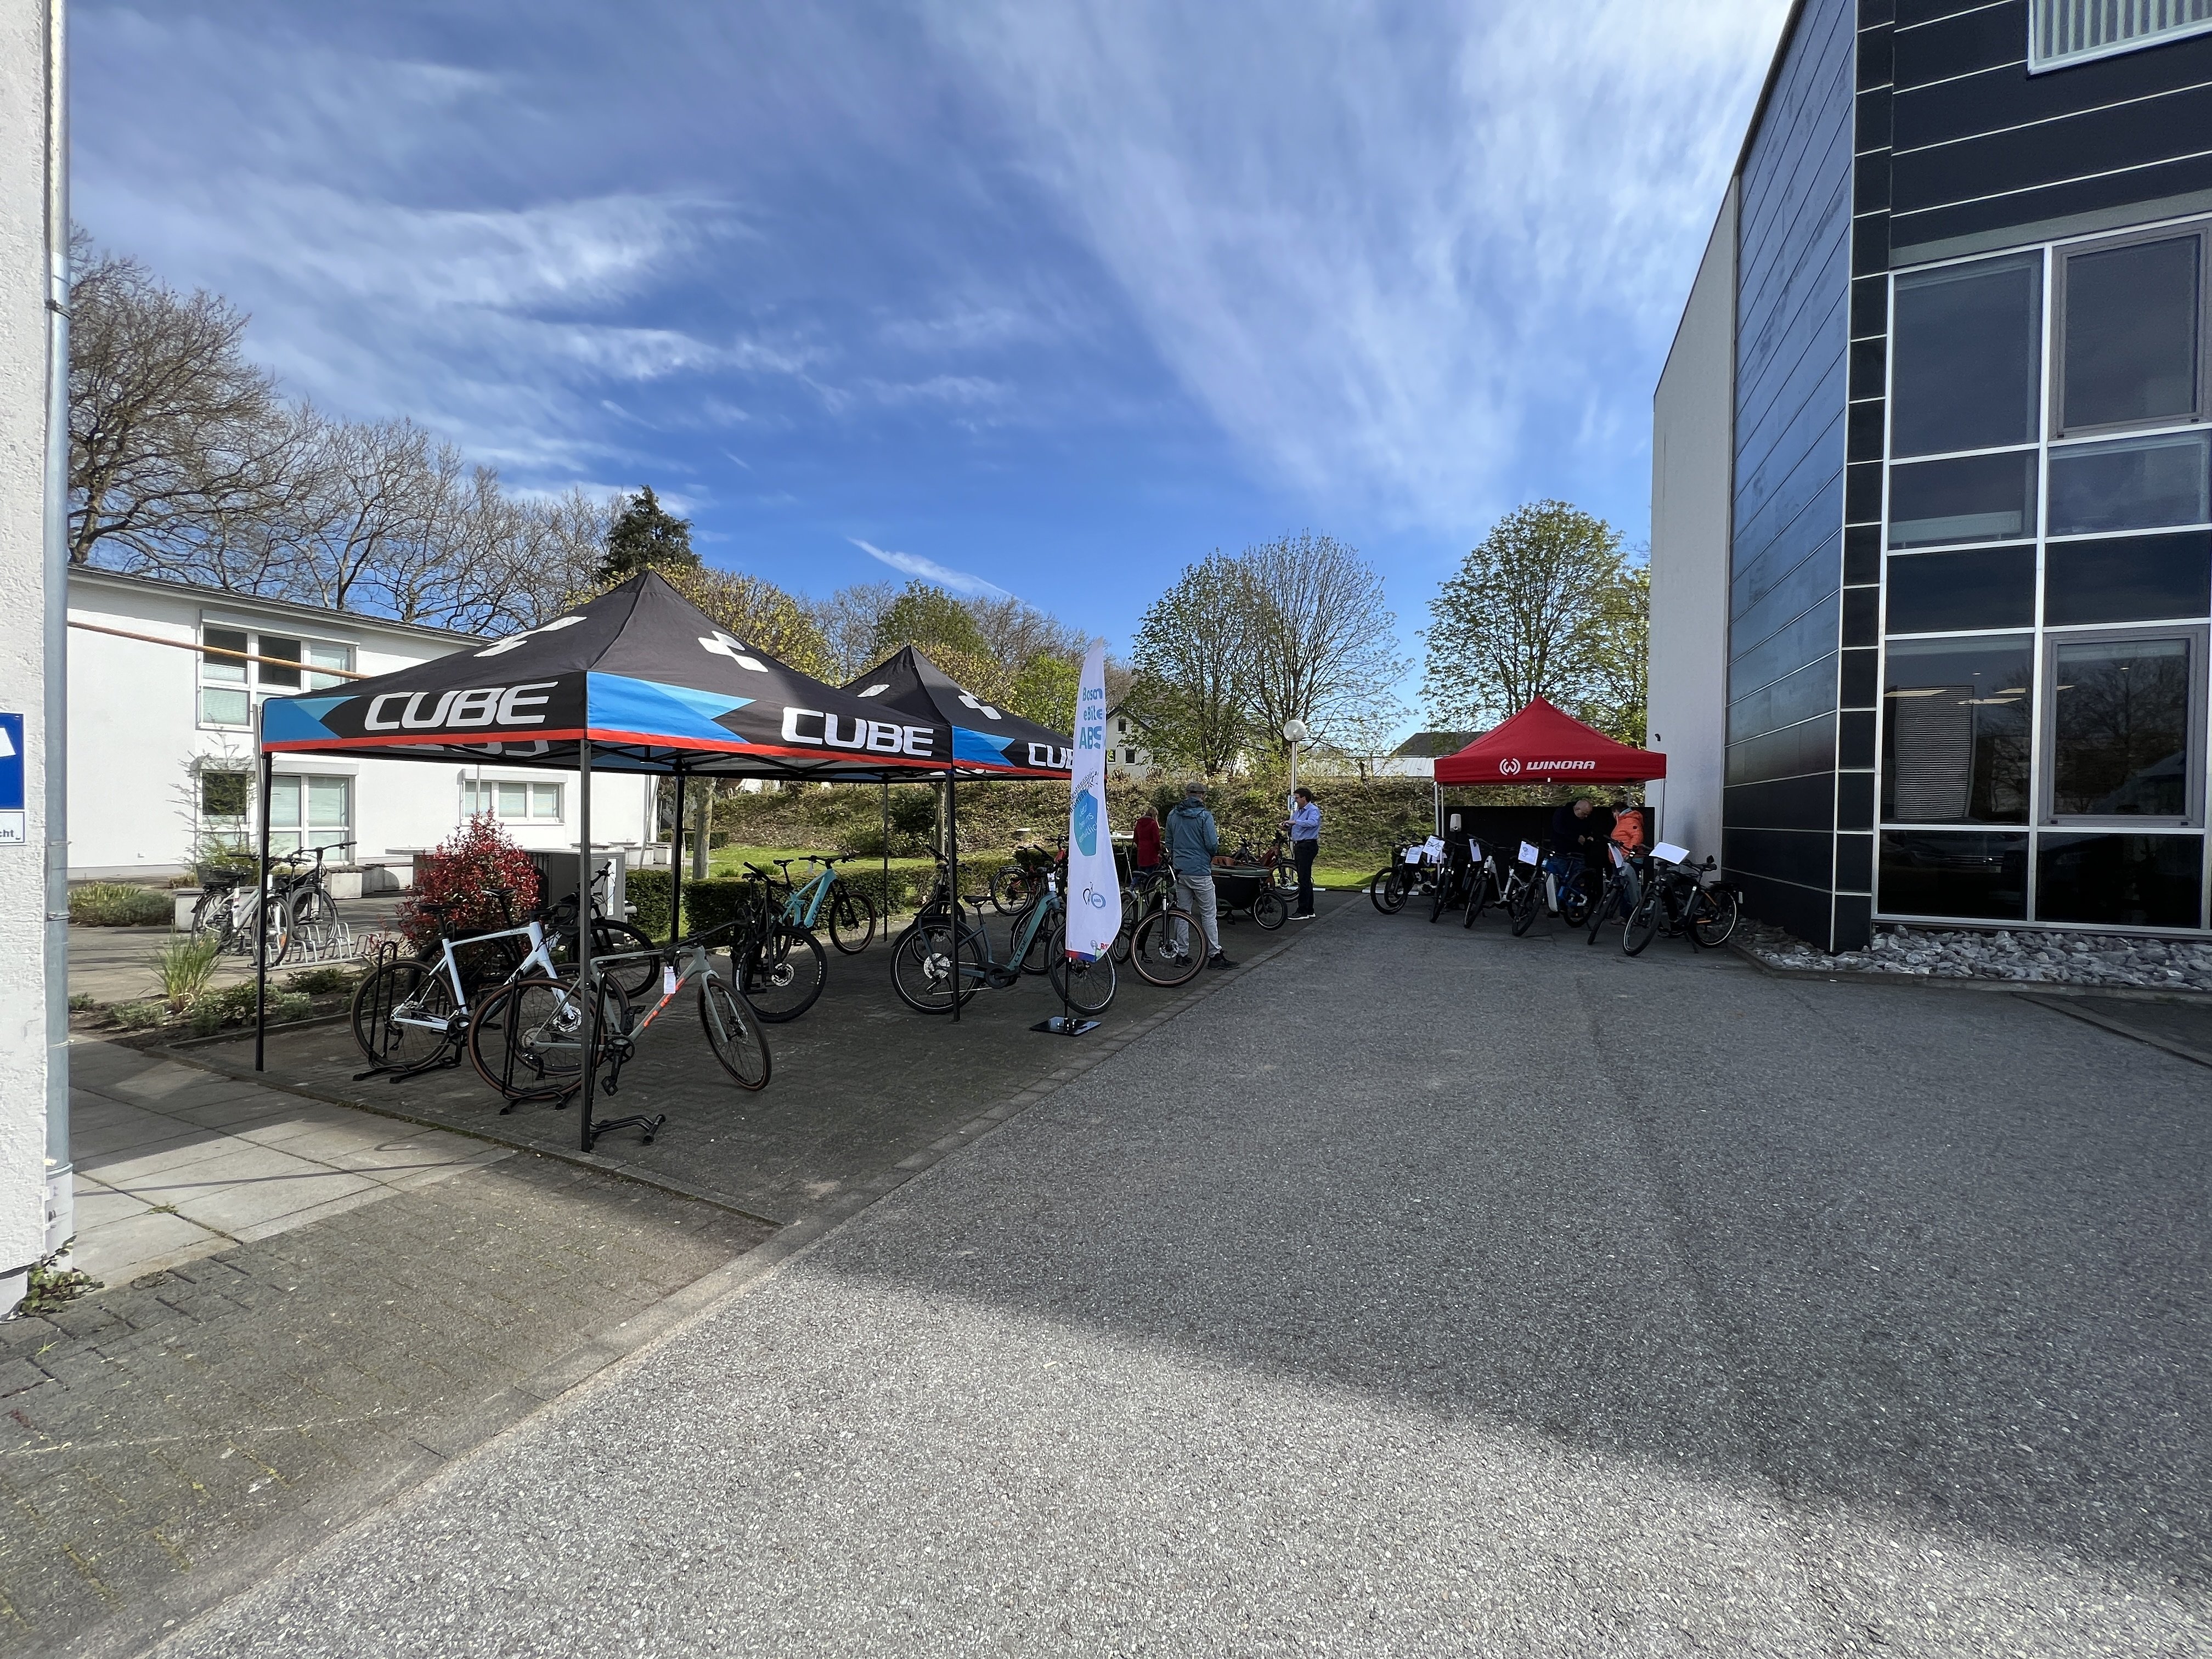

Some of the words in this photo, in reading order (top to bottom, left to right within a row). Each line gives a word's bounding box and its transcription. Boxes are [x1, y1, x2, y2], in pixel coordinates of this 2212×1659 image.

[364, 681, 558, 731] CUBE
[781, 707, 934, 756] CUBE
[1079, 726, 1102, 749] ABS
[1526, 761, 1595, 770] WINORA
[1014, 936, 1029, 963] CUBE
